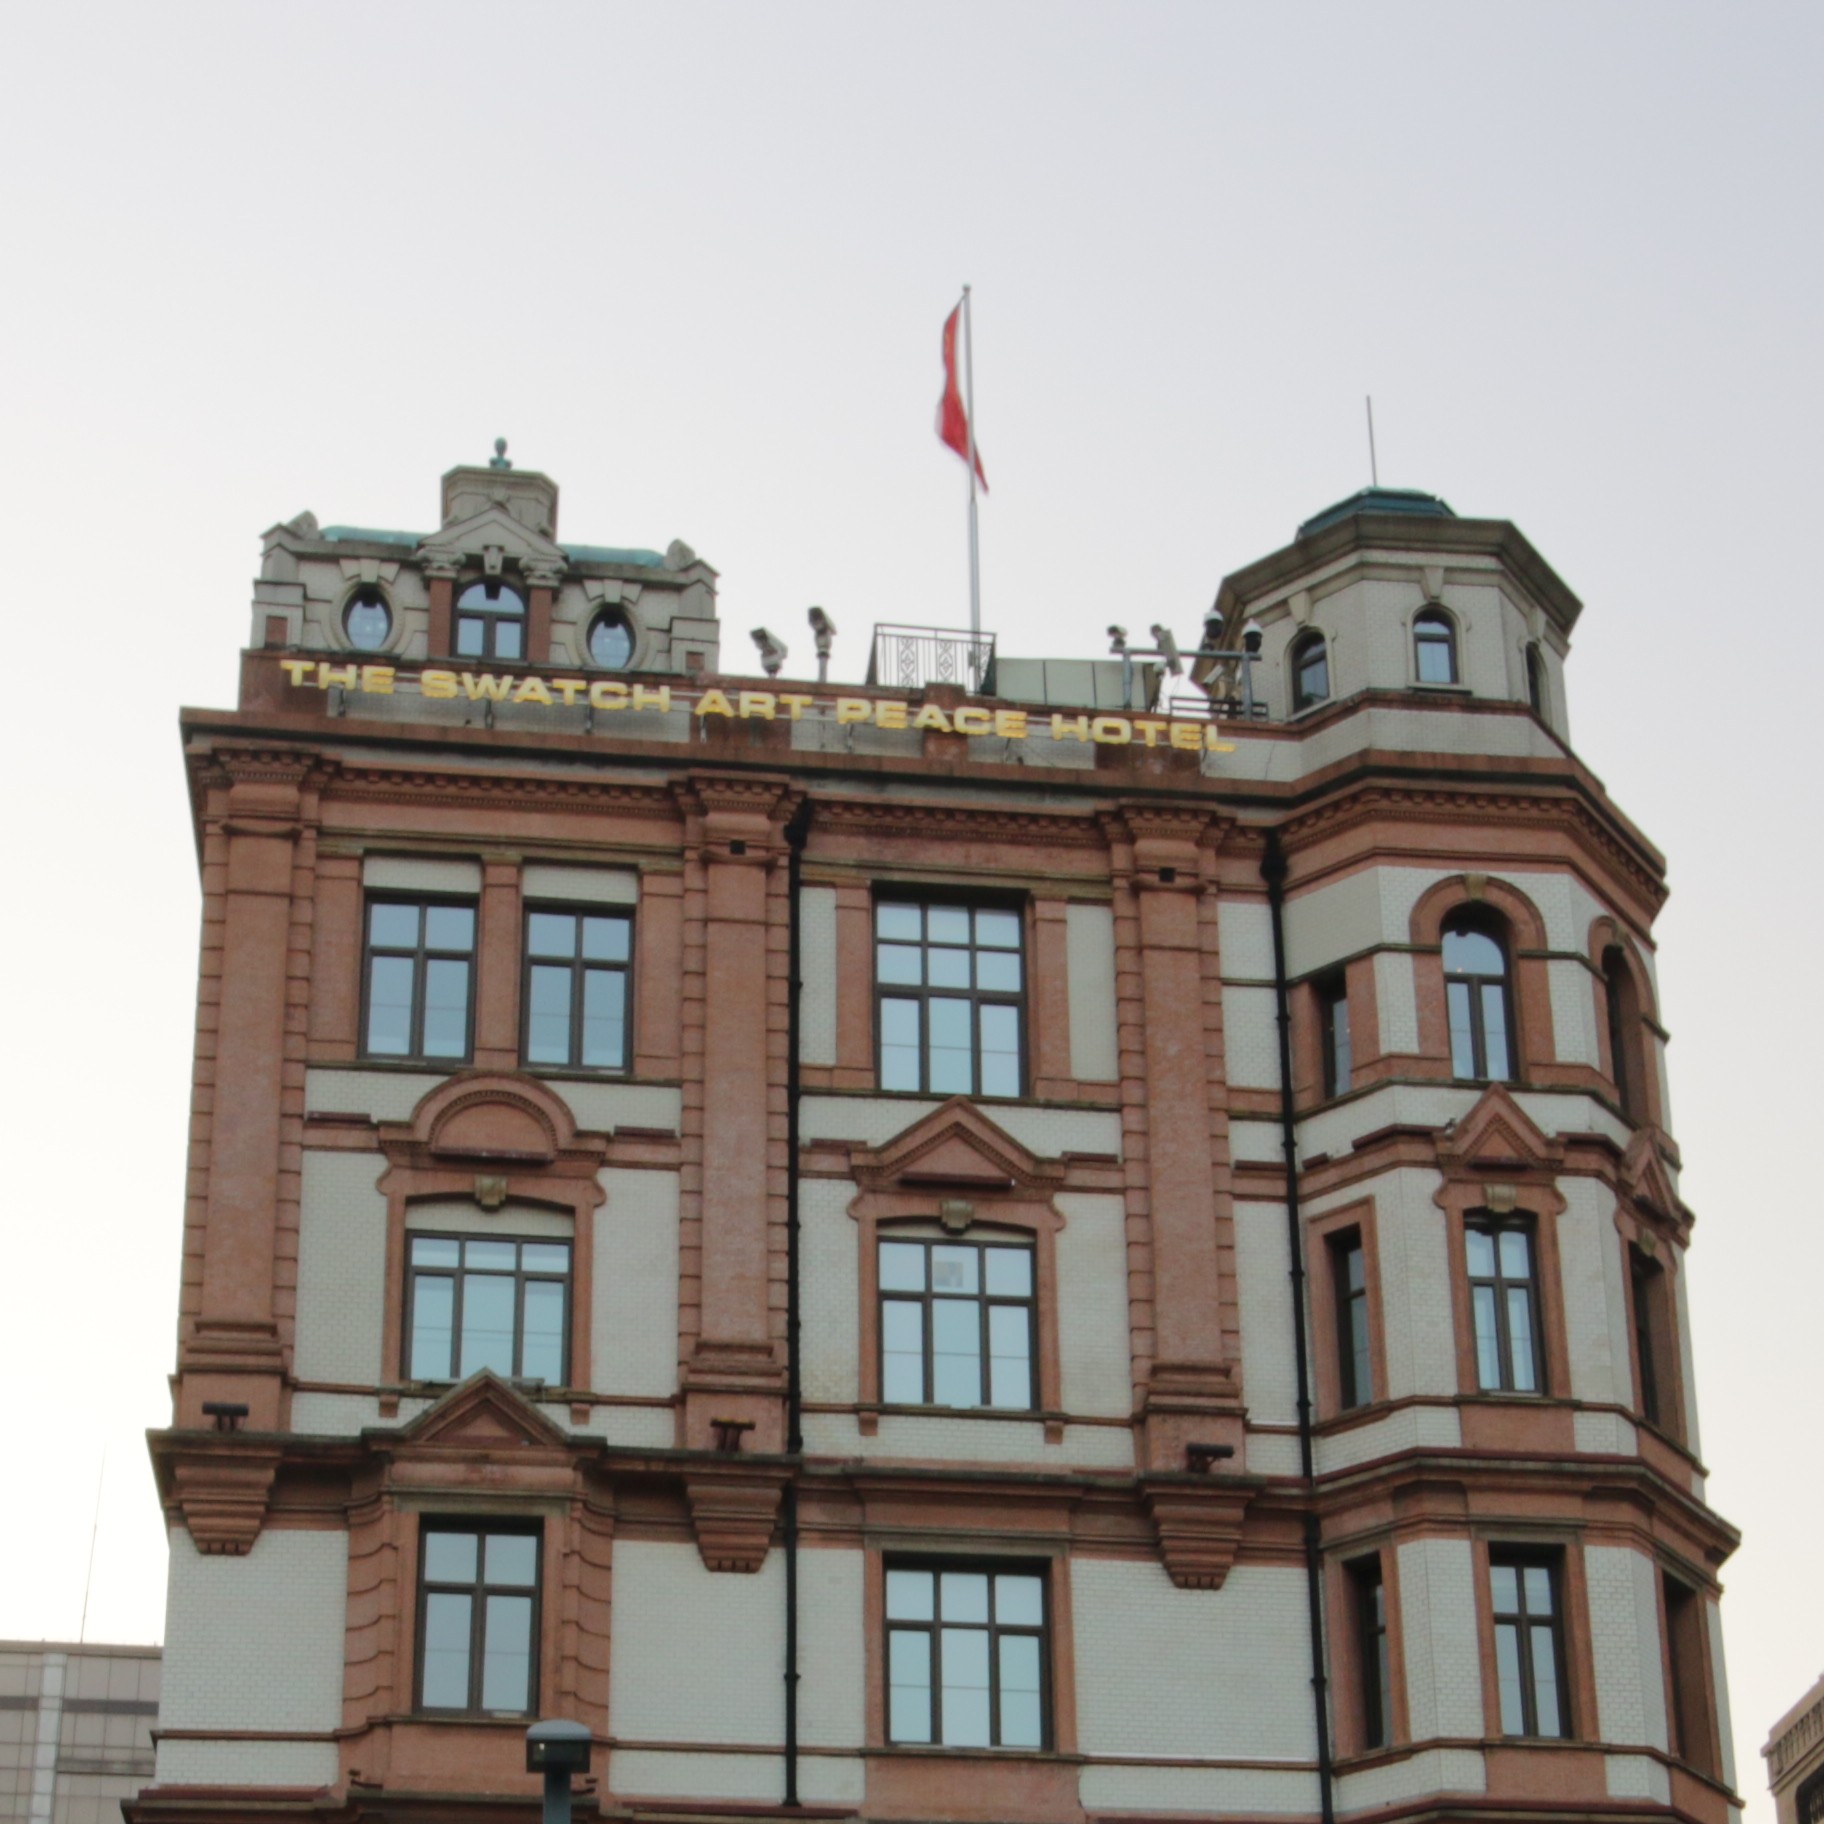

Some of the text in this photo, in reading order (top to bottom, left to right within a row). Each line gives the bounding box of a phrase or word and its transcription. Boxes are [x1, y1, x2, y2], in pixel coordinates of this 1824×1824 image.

[280, 660, 1236, 752] THE SWATCH ART PEACE HOTEL
